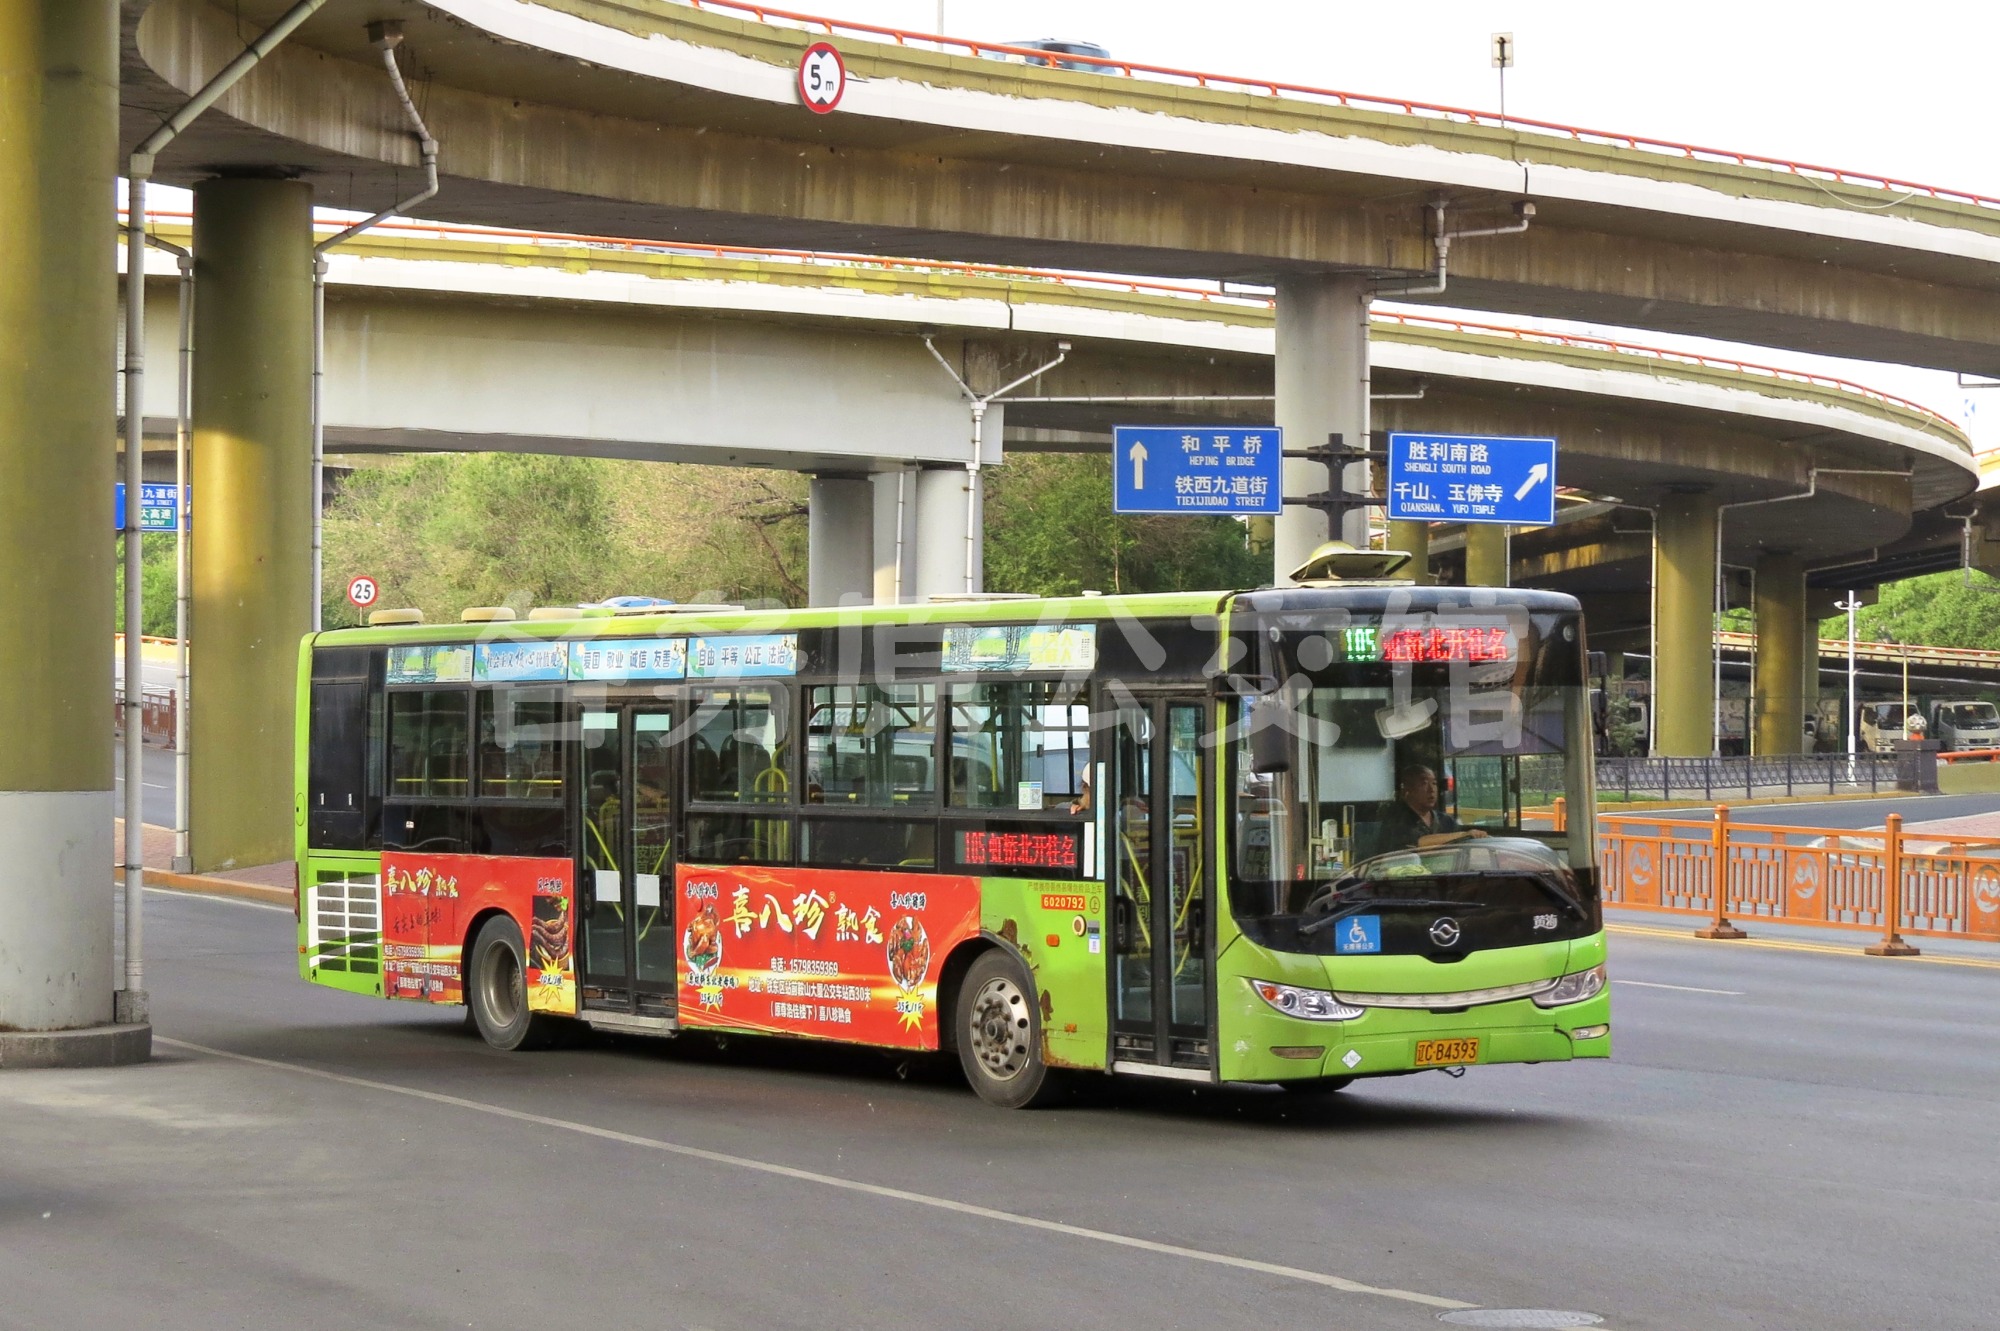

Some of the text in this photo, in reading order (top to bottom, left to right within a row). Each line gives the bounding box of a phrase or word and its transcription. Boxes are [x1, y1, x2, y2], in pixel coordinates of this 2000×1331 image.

[1181, 435, 1263, 455] 和平桥
[1408, 441, 1489, 463] 胜利南路
[1189, 457, 1255, 467] HEPING BRIDGE
[1404, 463, 1492, 476] SHENGLI SOUTH ROAD
[1175, 476, 1268, 496] 铁西九道街
[1393, 483, 1504, 503] 千山、玉佛寺
[1176, 497, 1266, 507] TIEXIJIUDAO STREET
[1453, 505, 1470, 515] YUFO
[1472, 505, 1496, 516] TEMPLE
[141, 509, 171, 519] 大高速
[355, 584, 371, 600] 25
[486, 646, 558, 669] 社会主义核心价值观
[583, 649, 672, 670] 爱国 敬业 诚信 友善
[697, 646, 786, 667] 自由 平等 公正 法治
[964, 832, 987, 864] 105
[384, 865, 459, 898] 喜八珍 熟食
[1043, 896, 1084, 909] 6020792
[723, 884, 884, 945] 喜八珍 熟食
[1533, 913, 1558, 929] 黄海
[1417, 1042, 1477, 1062] 辽C·B4393
